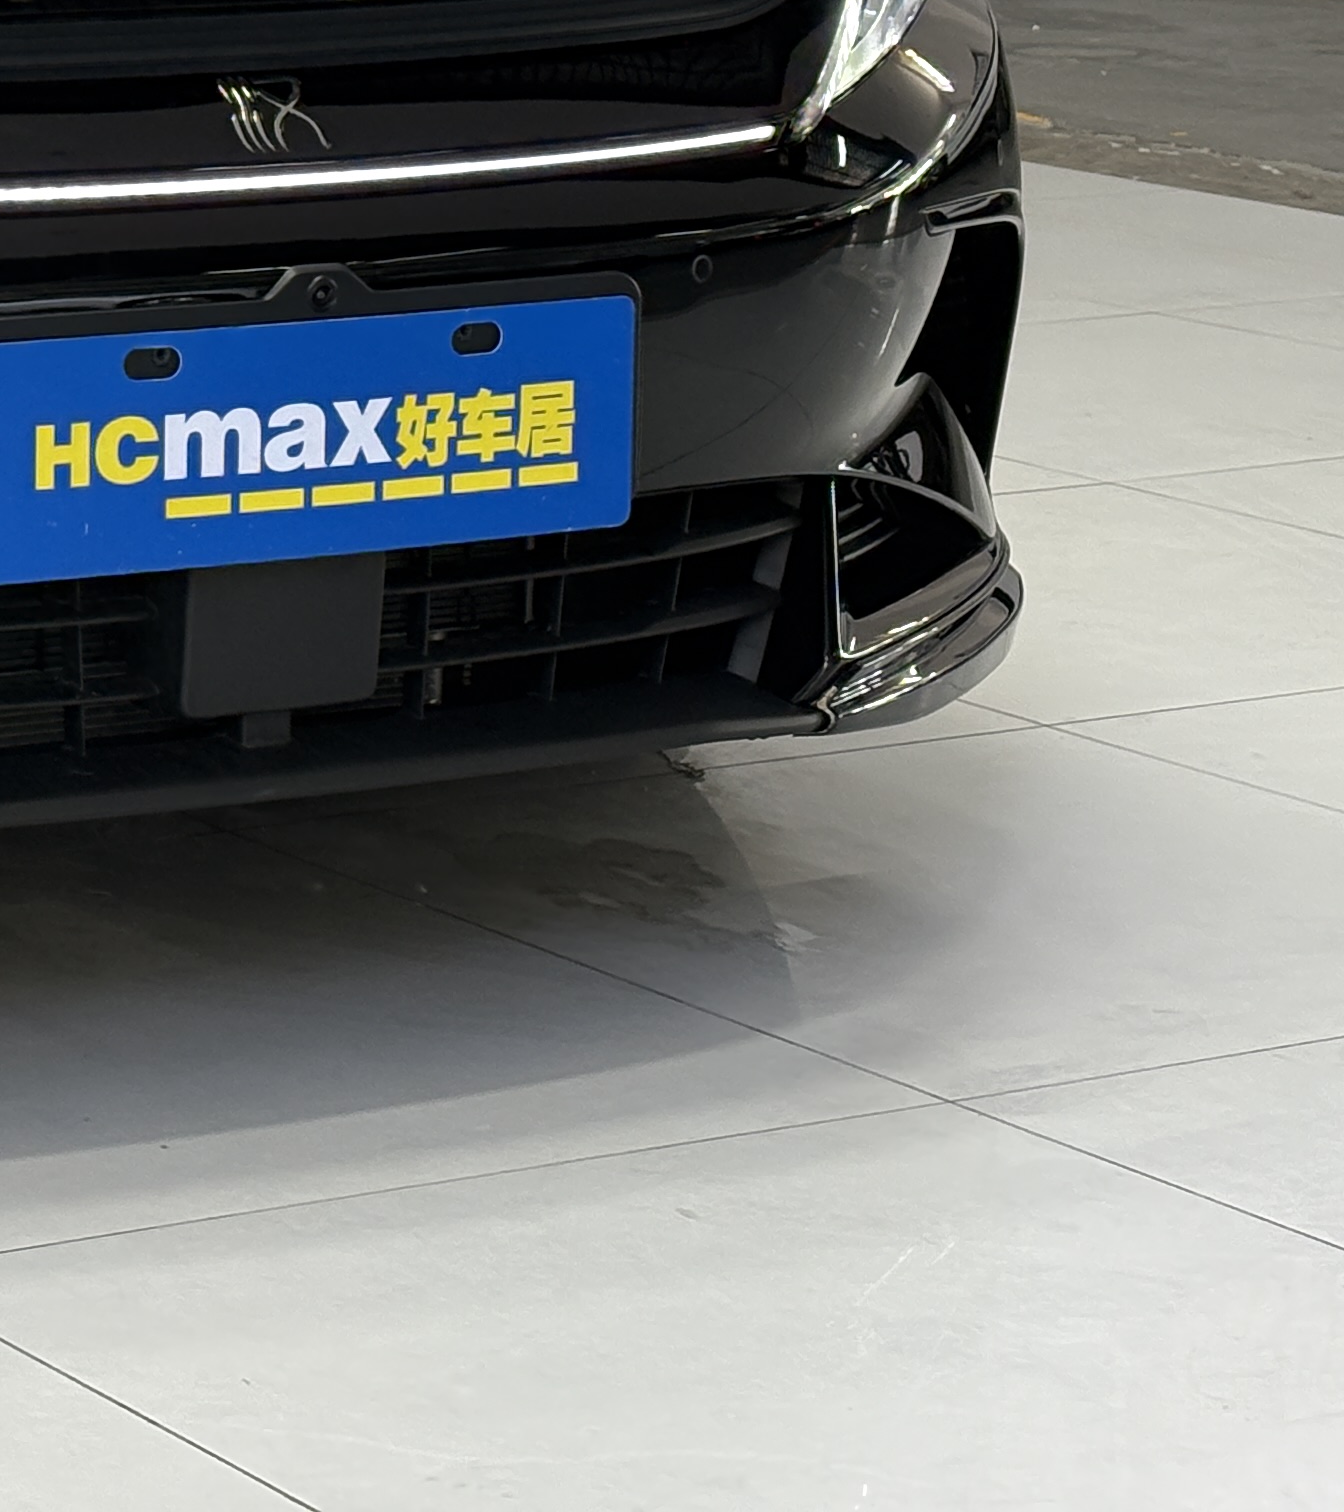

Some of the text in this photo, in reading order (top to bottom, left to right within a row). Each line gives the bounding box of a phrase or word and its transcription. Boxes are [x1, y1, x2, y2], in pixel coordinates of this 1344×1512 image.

[34, 380, 576, 491] HCmax 好车居
